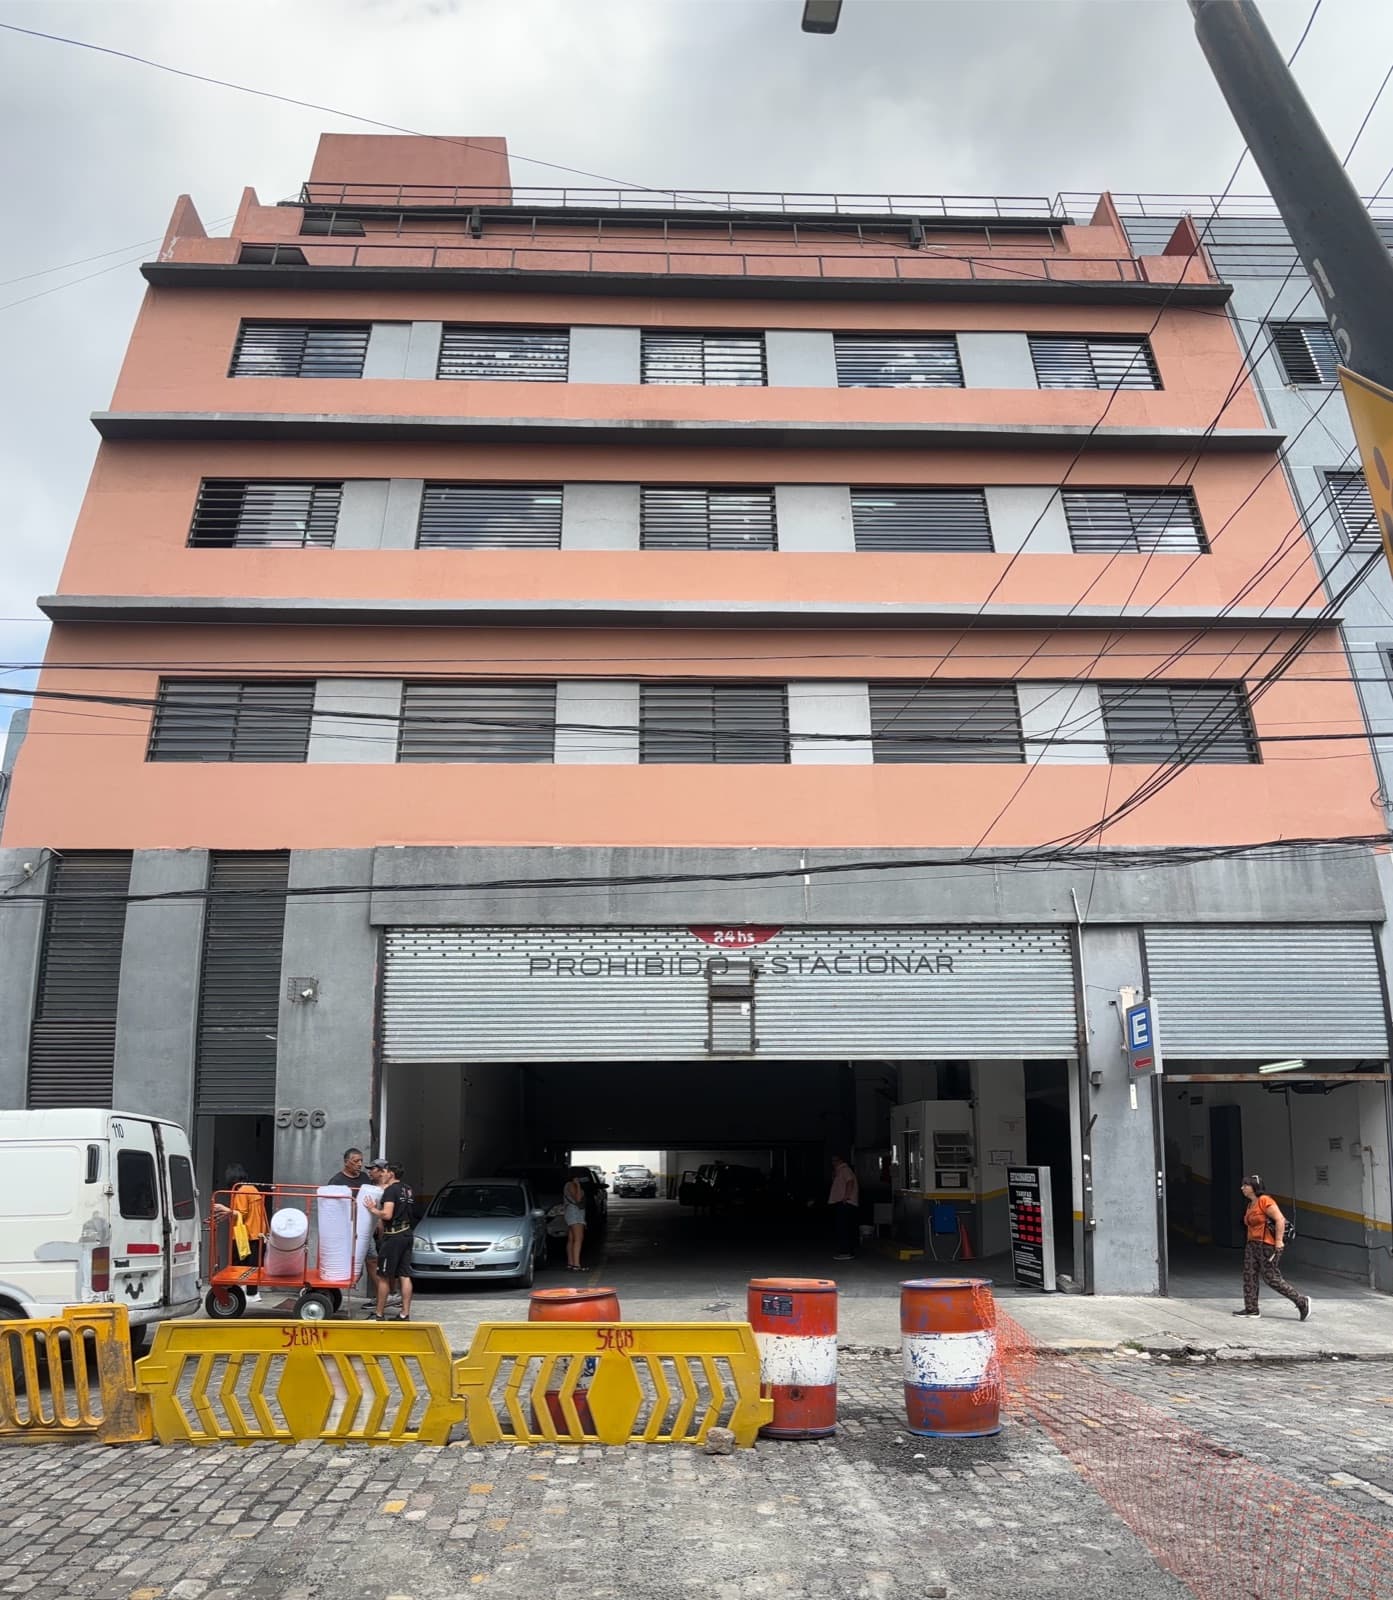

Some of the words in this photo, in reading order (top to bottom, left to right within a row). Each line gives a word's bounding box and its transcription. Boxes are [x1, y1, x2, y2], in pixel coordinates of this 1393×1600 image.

[530, 956, 728, 976] PROHIBIDO
[748, 955, 954, 975] ESTACIONAR
[1131, 1012, 1148, 1045] E
[276, 1108, 326, 1129] 566
[111, 1122, 124, 1139] 110
